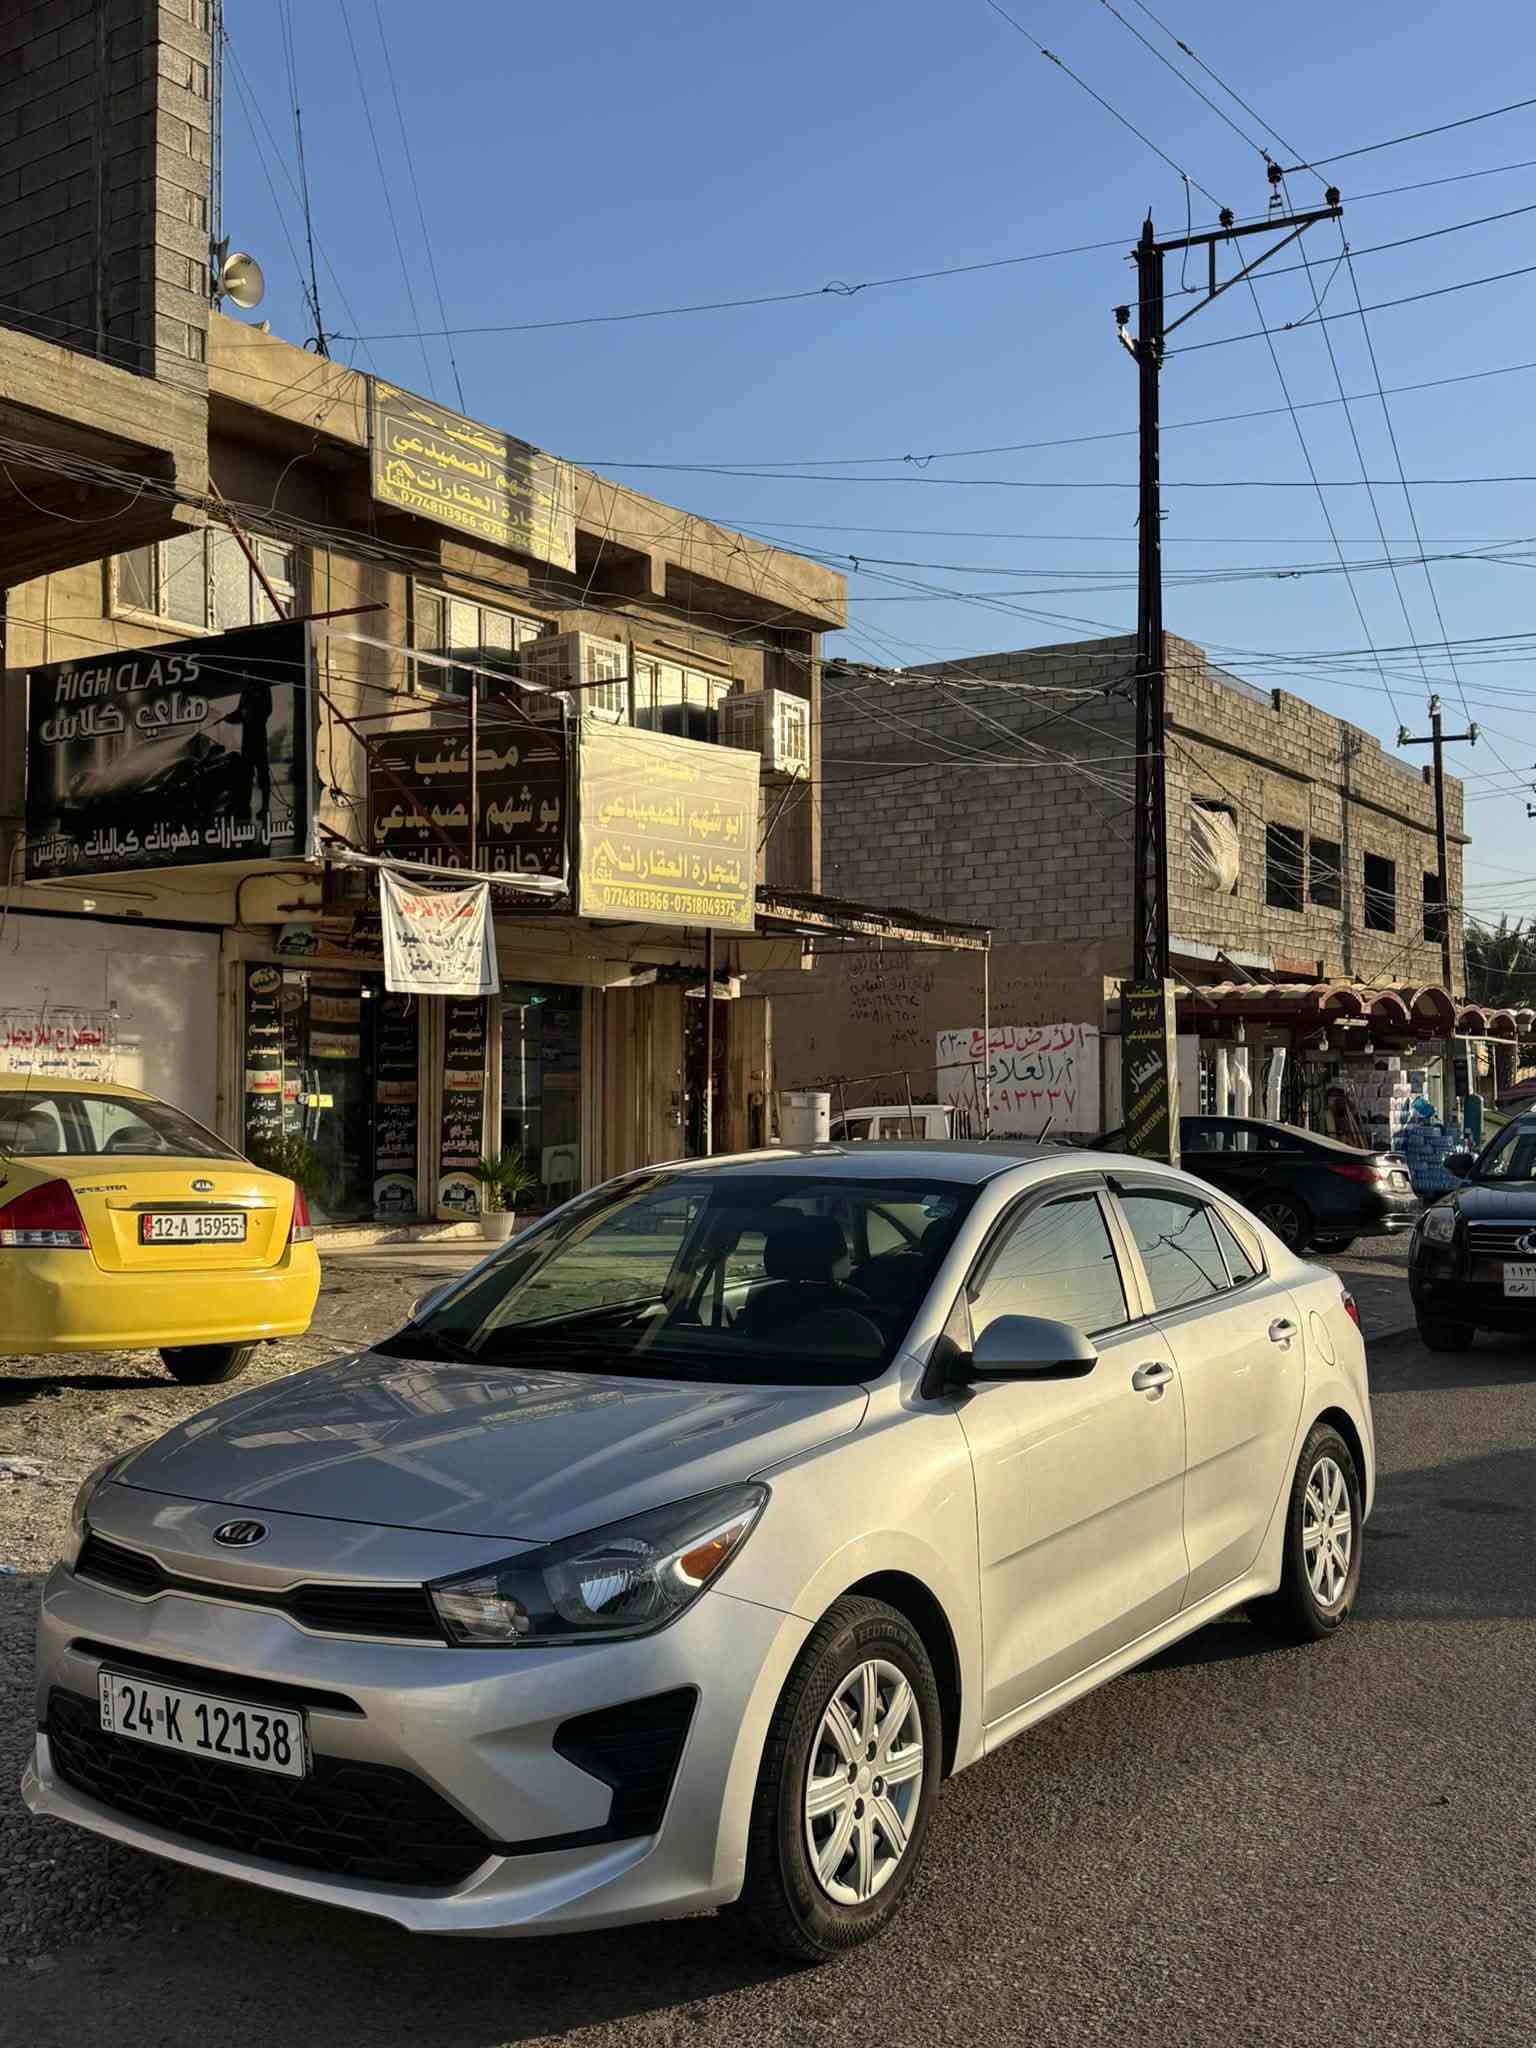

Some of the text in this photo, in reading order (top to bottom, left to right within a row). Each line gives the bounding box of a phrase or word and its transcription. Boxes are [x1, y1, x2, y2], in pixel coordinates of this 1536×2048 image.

[54, 654, 200, 703] HIGH CLASS
[40, 692, 208, 743] هاي كلاس
[415, 737, 519, 785] مكتب
[261, 808, 296, 846] غسل
[487, 785, 533, 838] شهم
[688, 803, 722, 838] شهم
[84, 829, 140, 860] كماليات
[144, 822, 200, 854] دهونات
[204, 814, 256, 849] سيارات
[618, 845, 741, 891] لتجارة العقارات
[194, 1217, 240, 1237] 15955
[216, 1521, 263, 1544] KIA
[194, 1703, 292, 1767] 12138
